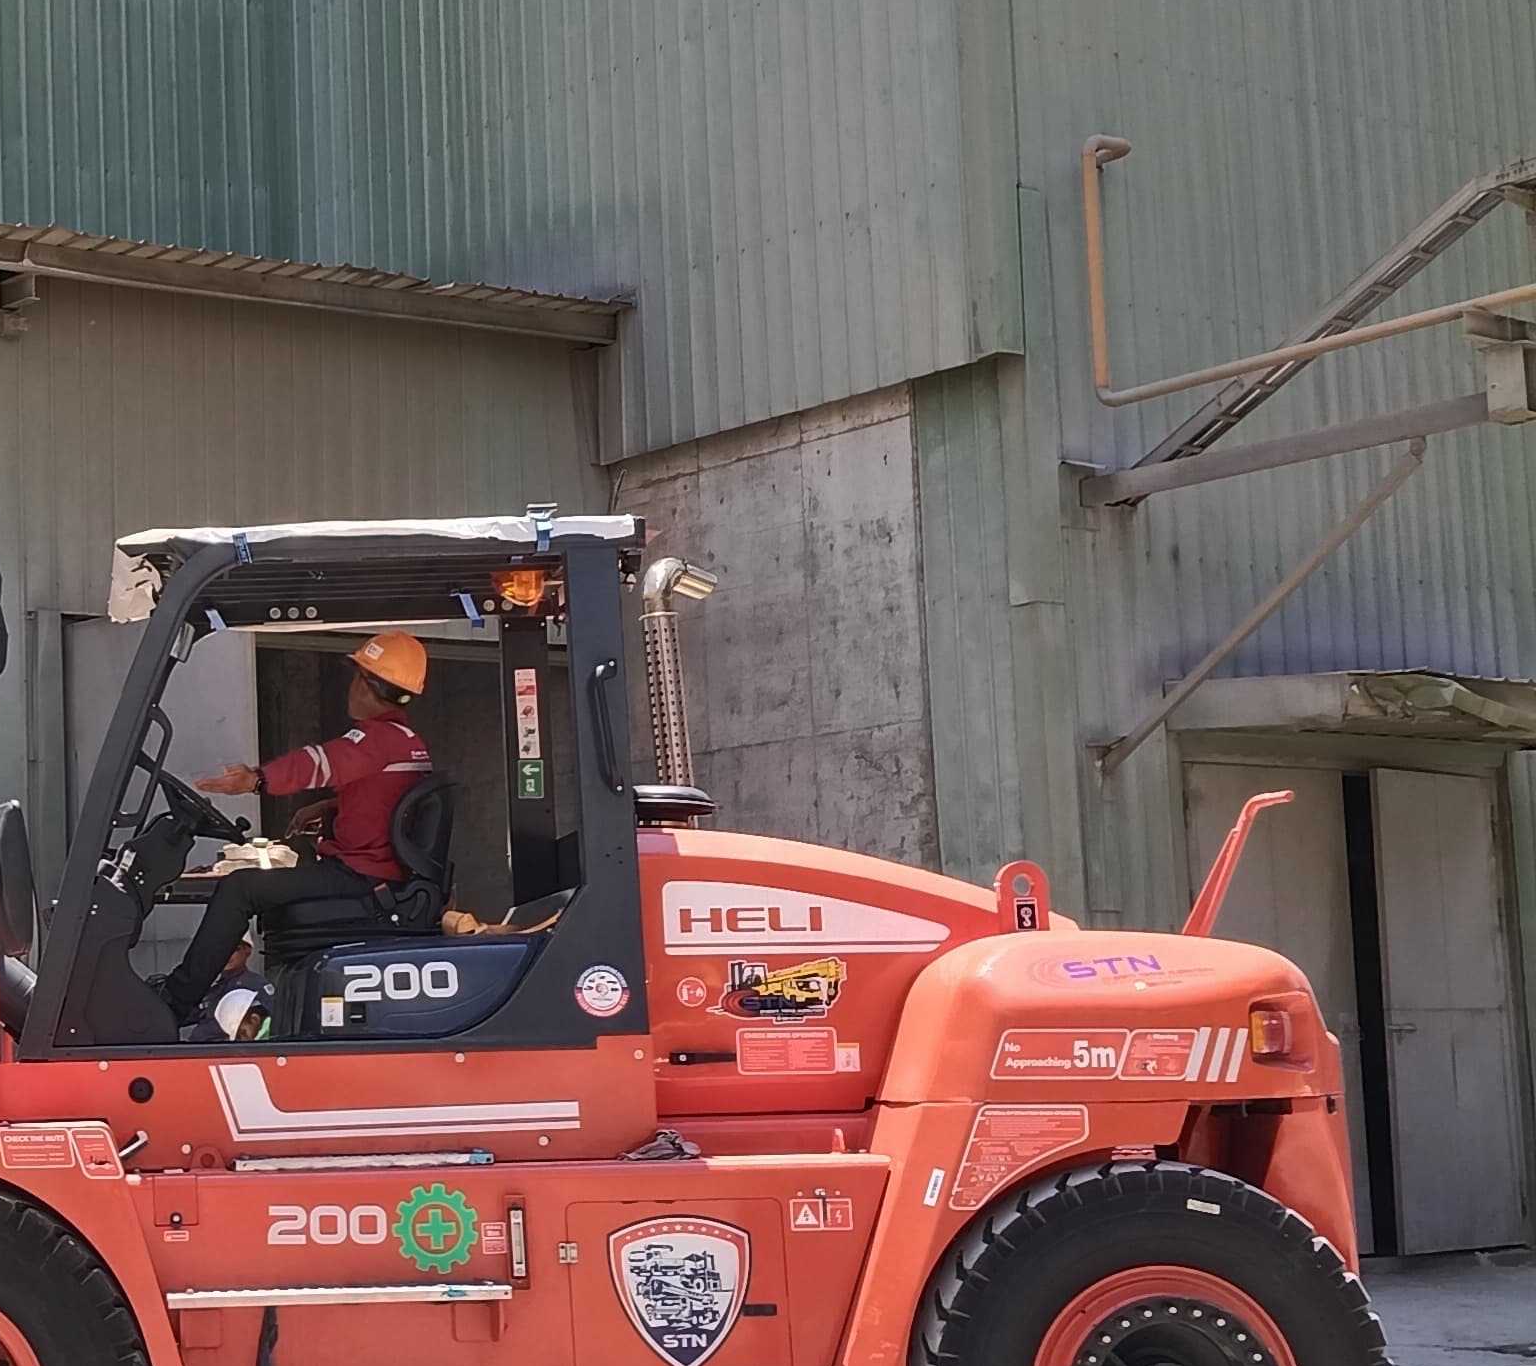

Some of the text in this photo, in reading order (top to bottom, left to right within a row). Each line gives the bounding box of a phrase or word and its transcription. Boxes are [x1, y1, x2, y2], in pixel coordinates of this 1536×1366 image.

[678, 906, 823, 934] HELI
[1062, 954, 1162, 980] STN
[344, 961, 459, 1002] 200
[742, 995, 797, 1010] STN
[1004, 1042, 1021, 1052] No
[1004, 1057, 1072, 1070] Approaching
[1073, 1040, 1116, 1068] 5m
[267, 1205, 387, 1245] 200
[663, 1334, 708, 1348] STN
